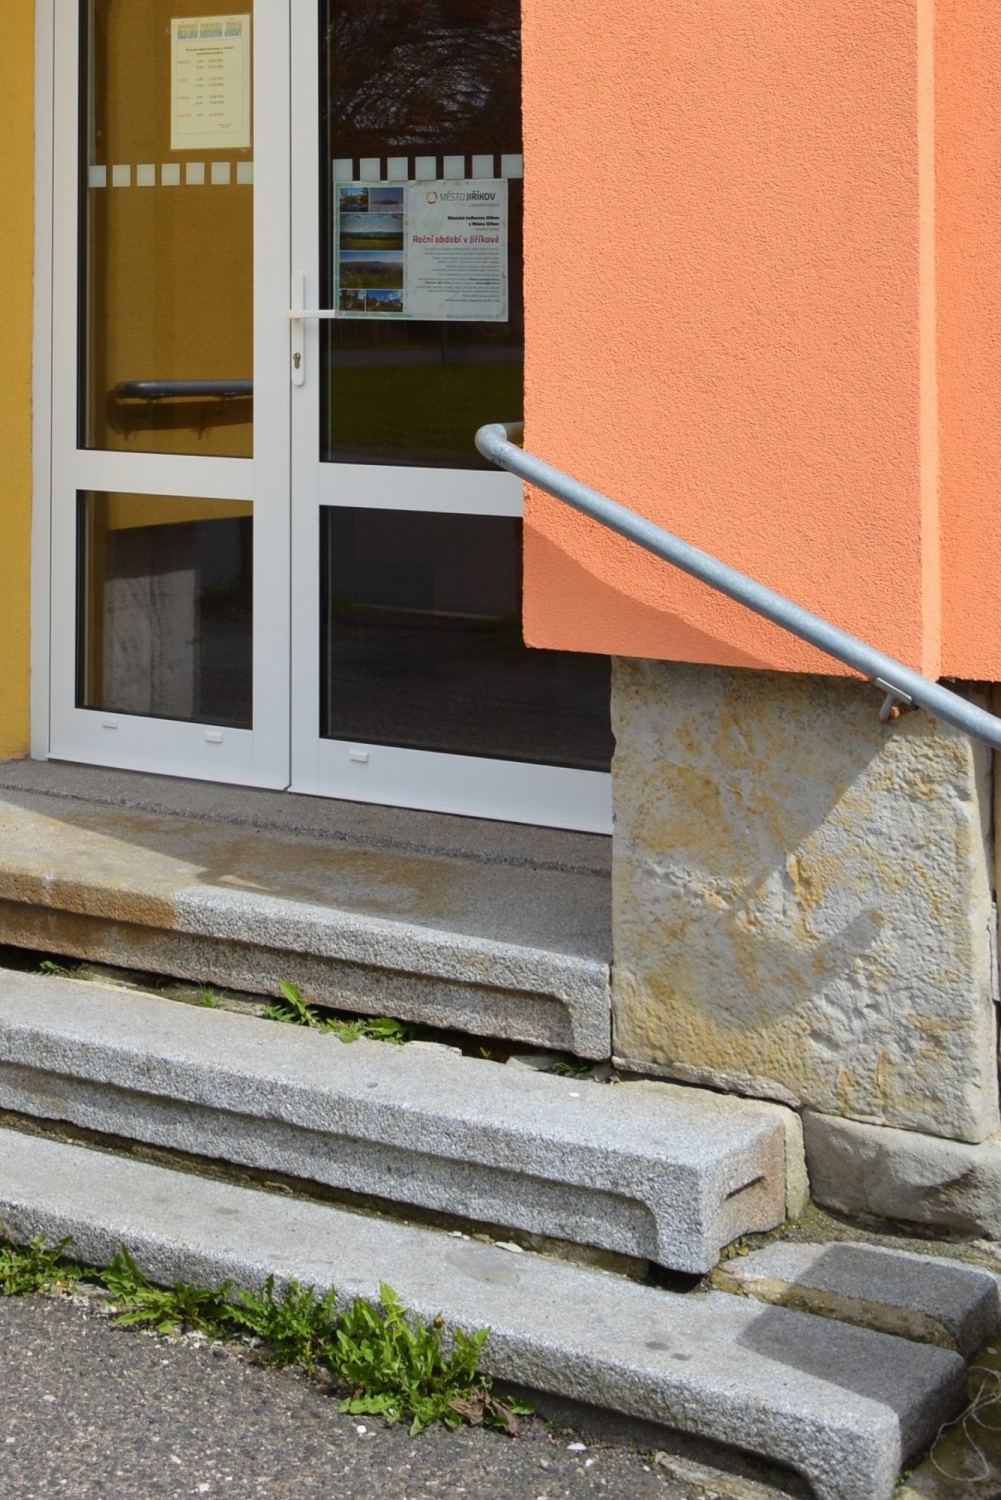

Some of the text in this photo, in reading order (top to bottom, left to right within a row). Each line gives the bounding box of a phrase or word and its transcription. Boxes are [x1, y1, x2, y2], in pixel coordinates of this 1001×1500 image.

[440, 190, 495, 201] MĚSTO JIŘÍKOV
[413, 235, 434, 244] Roční
[435, 235, 462, 243] období
[469, 235, 500, 244] Jiříkově
